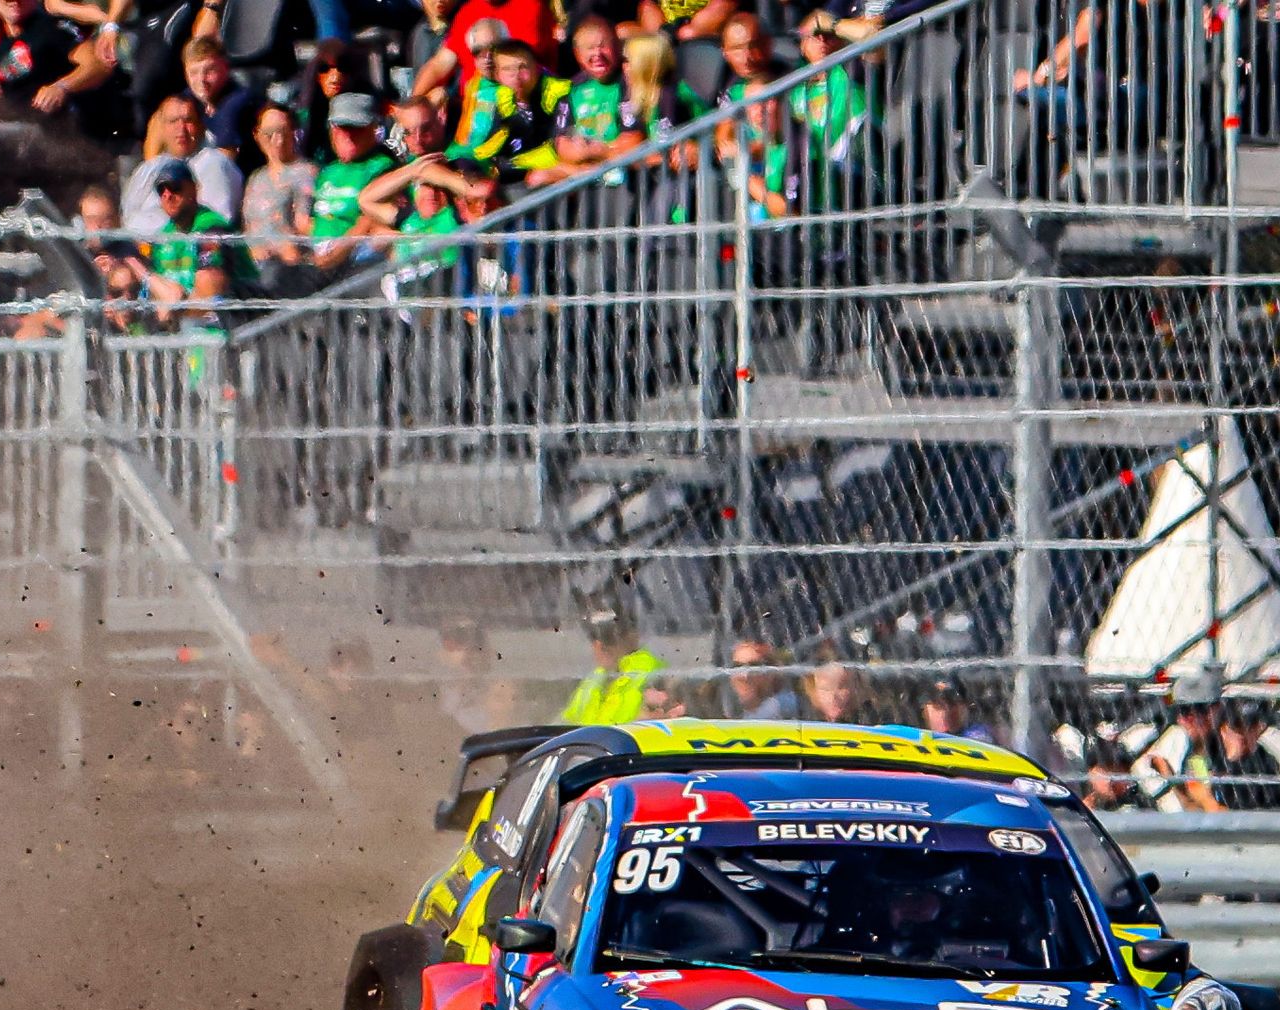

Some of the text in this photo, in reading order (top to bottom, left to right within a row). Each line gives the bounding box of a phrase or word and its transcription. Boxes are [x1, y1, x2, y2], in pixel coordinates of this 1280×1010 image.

[687, 737, 989, 761] MARTIN
[763, 800, 915, 813] RAVENOL
[758, 822, 931, 845] BELEVSKIY
[993, 830, 1043, 853] FIA
[613, 846, 685, 894] 95
